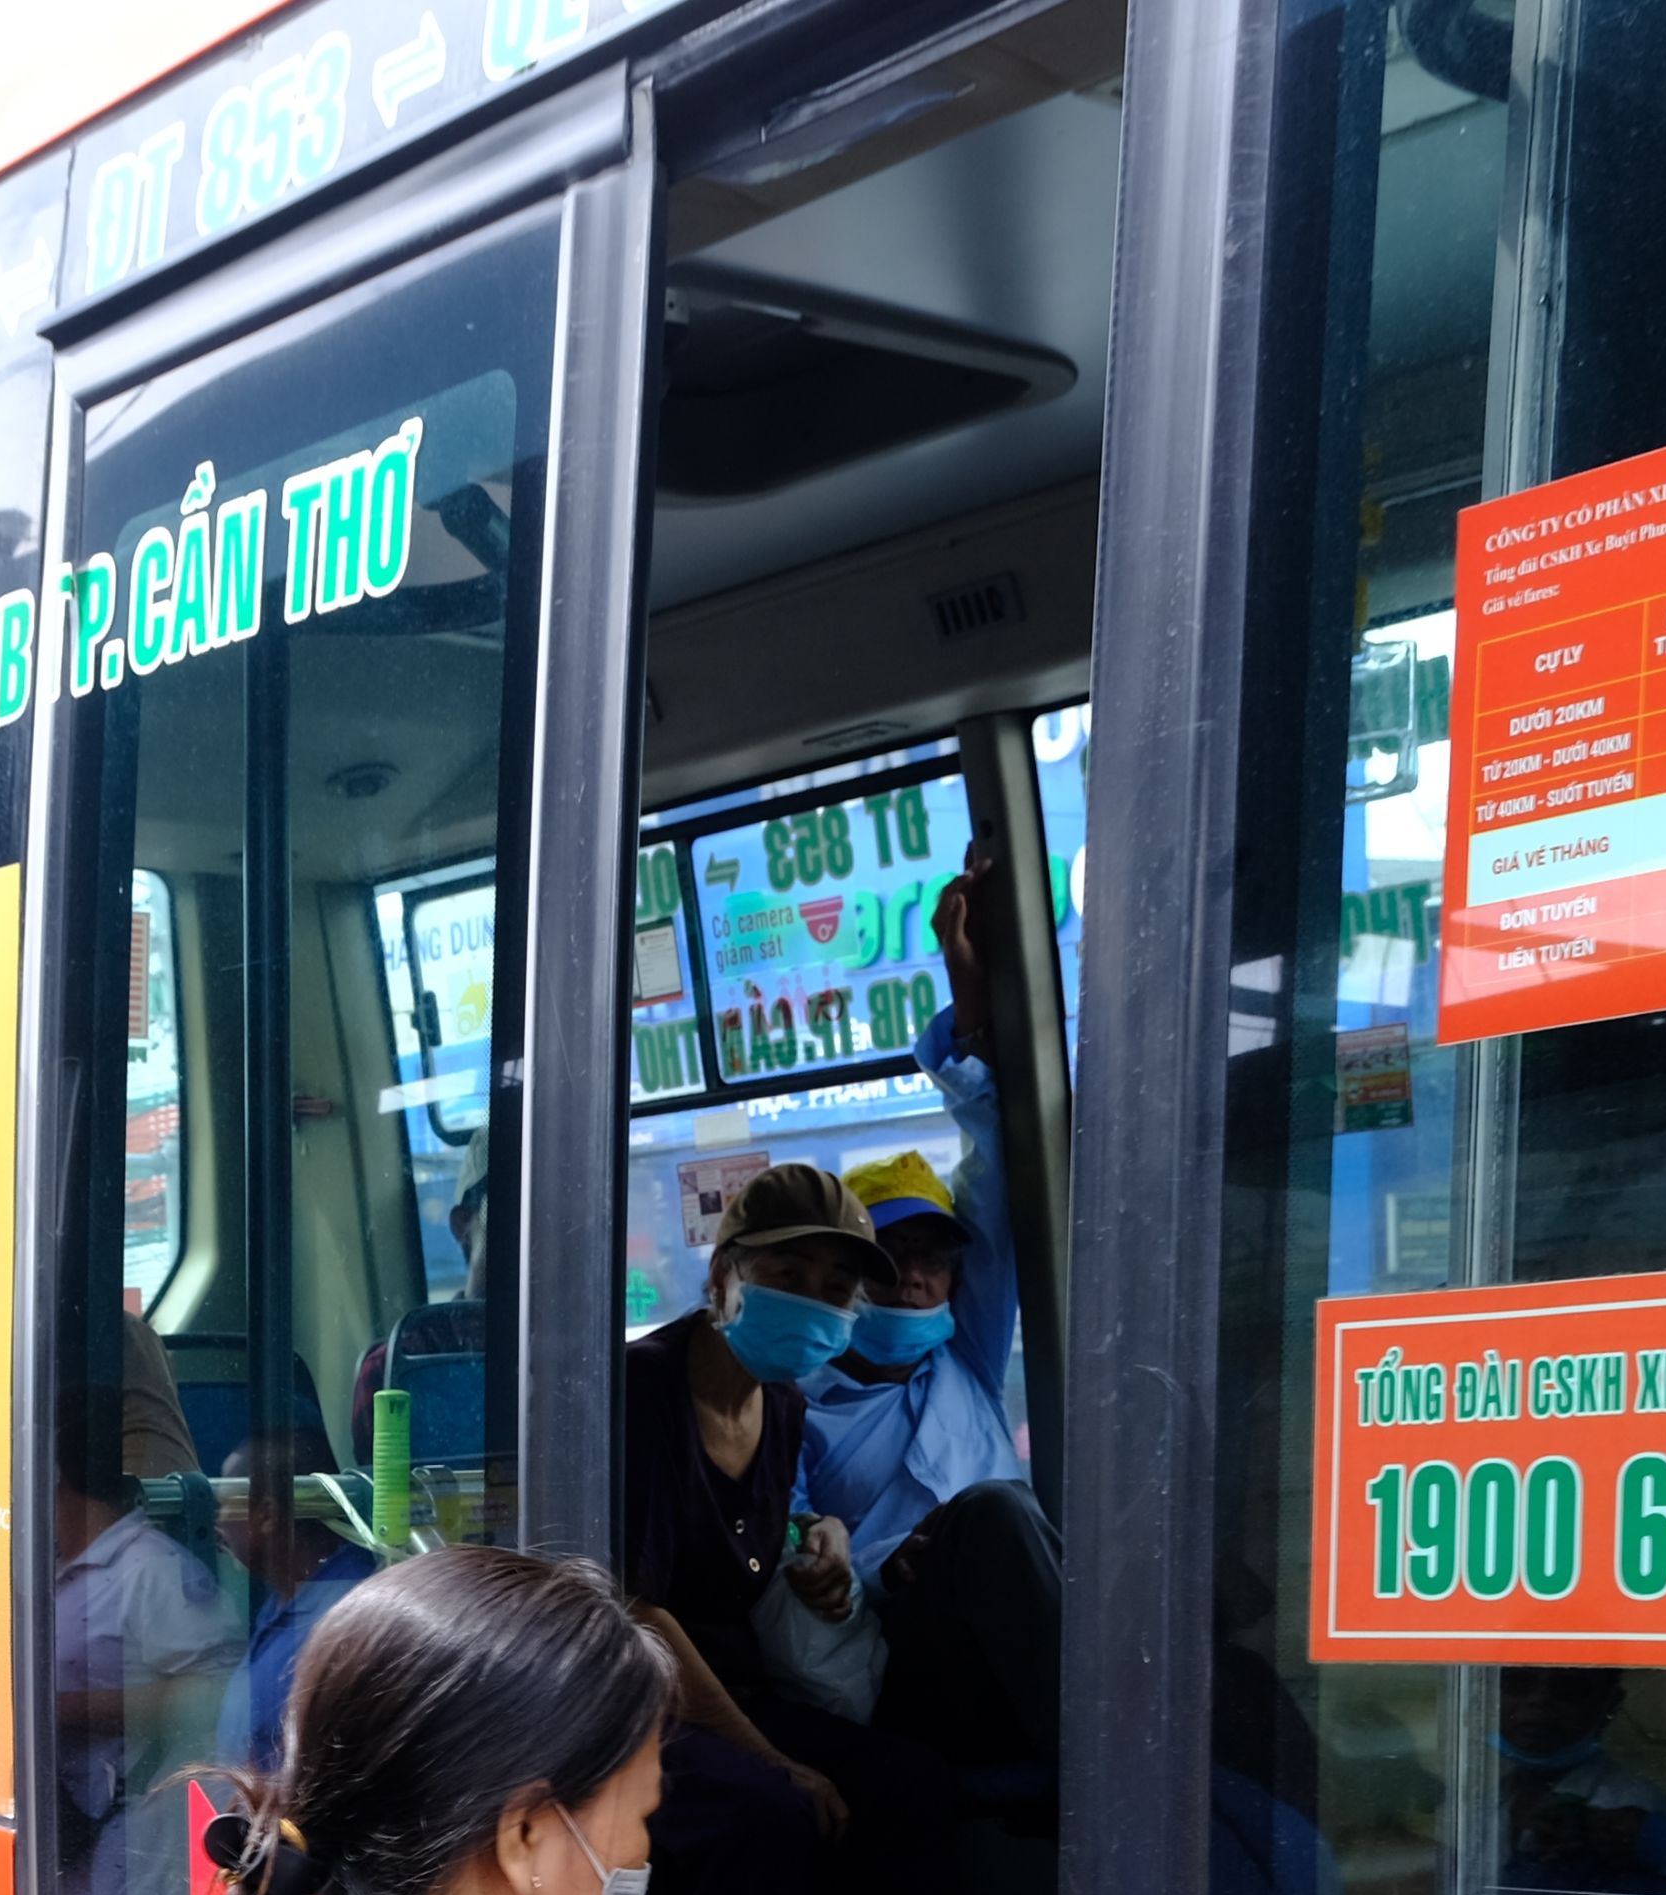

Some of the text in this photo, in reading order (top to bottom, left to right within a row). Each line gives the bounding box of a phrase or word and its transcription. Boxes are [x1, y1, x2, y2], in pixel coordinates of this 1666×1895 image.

[196, 35, 351, 236] 853
[282, 420, 423, 625] THƠ
[1538, 515, 1561, 538] TY
[1583, 540, 1604, 558] Xe
[1554, 696, 1606, 726] 20KM
[1491, 850, 1521, 877] GIÁ
[1524, 845, 1548, 869] VÉ
[1549, 835, 1611, 864] THÁNG
[737, 905, 795, 935] camera
[1539, 892, 1598, 924] TUYẾN
[1536, 935, 1598, 966] TUYẾN
[1356, 1345, 1446, 1428] TỔNG
[1456, 1347, 1520, 1422] ĐÀI
[1528, 1352, 1630, 1417] CSKH
[1364, 1454, 1585, 1603] 1900
